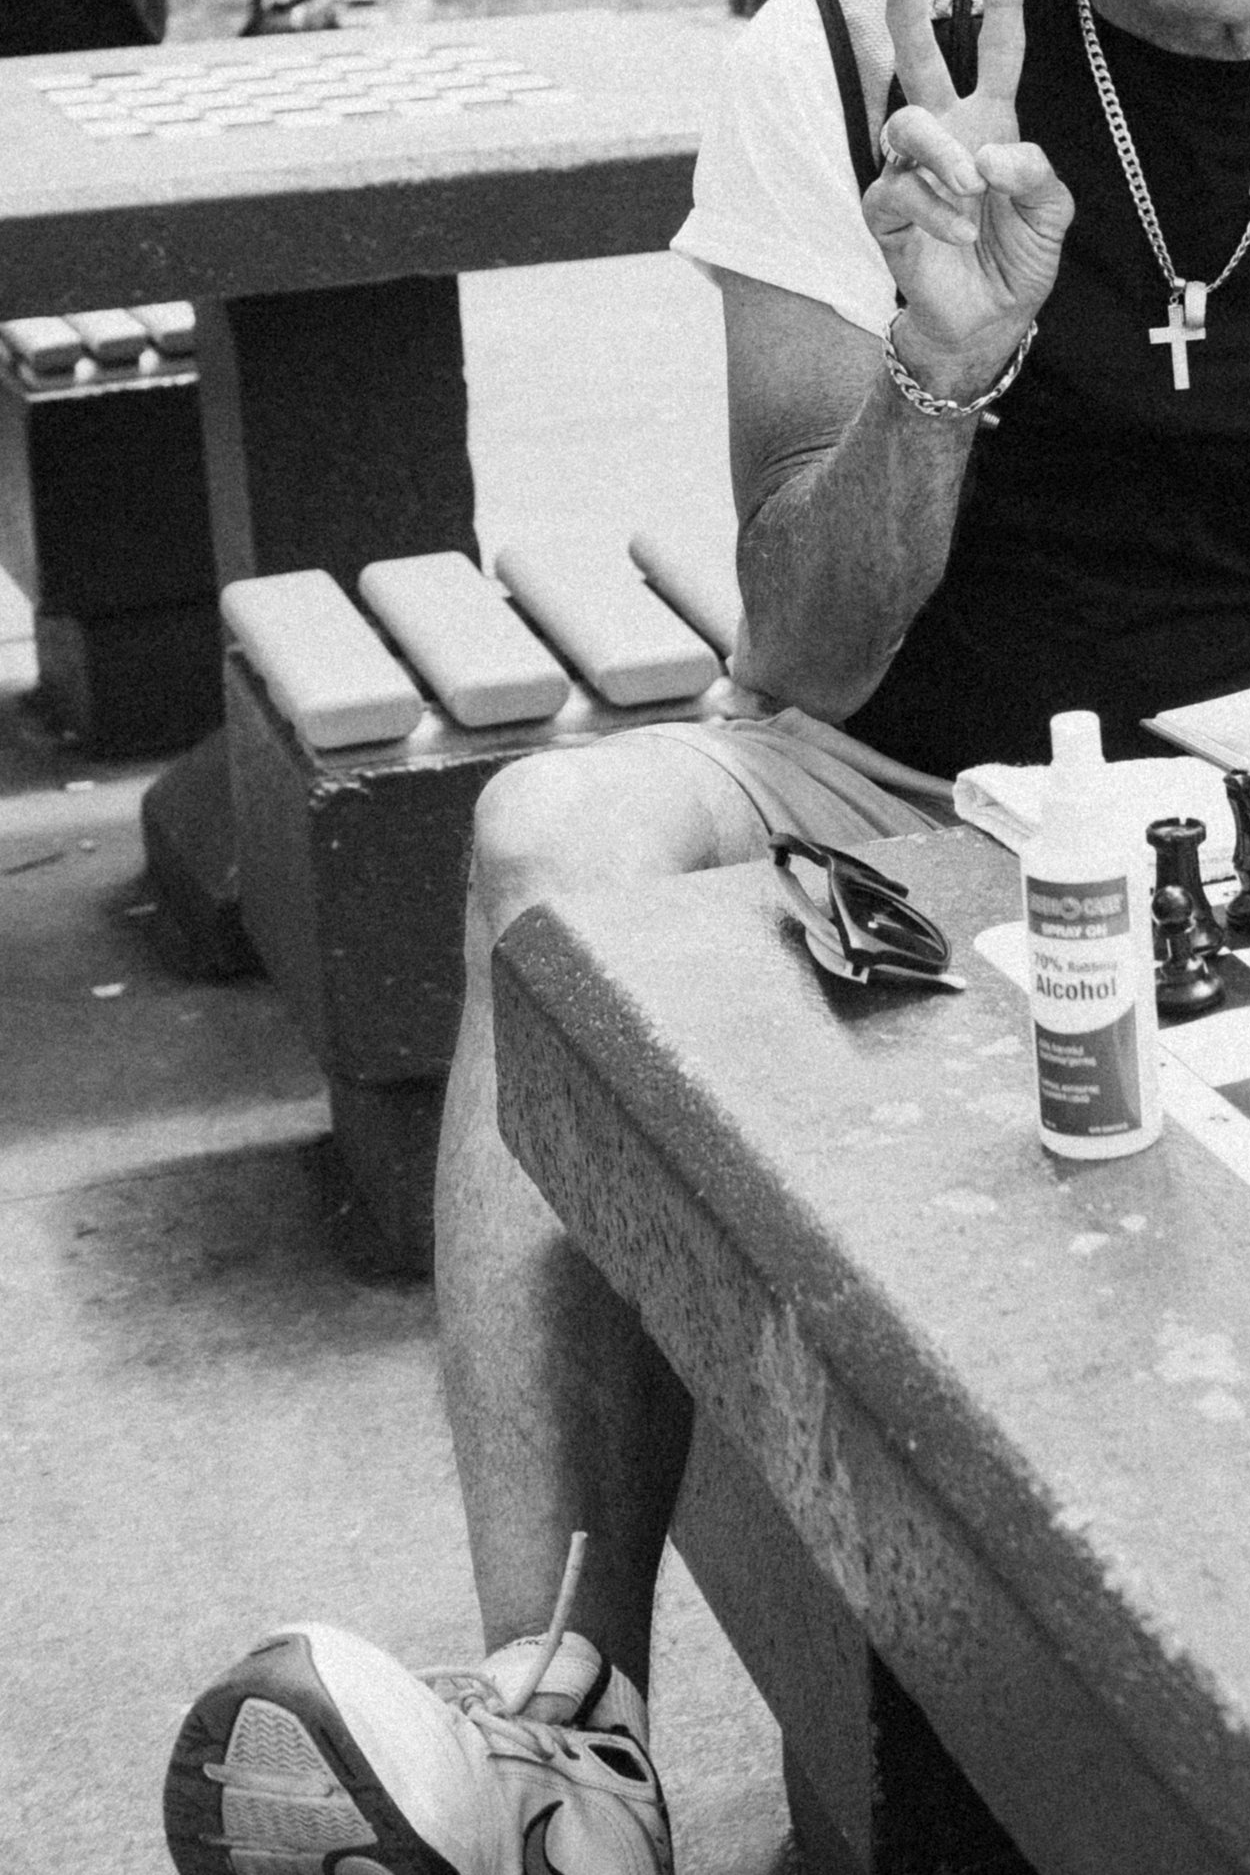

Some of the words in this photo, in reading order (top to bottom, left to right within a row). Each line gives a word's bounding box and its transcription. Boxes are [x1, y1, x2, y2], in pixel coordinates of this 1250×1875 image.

[1041, 922, 1082, 938] SPRAY
[1085, 923, 1108, 938] ON
[1033, 952, 1063, 973] 70%
[1036, 974, 1117, 1001] Alcohol
